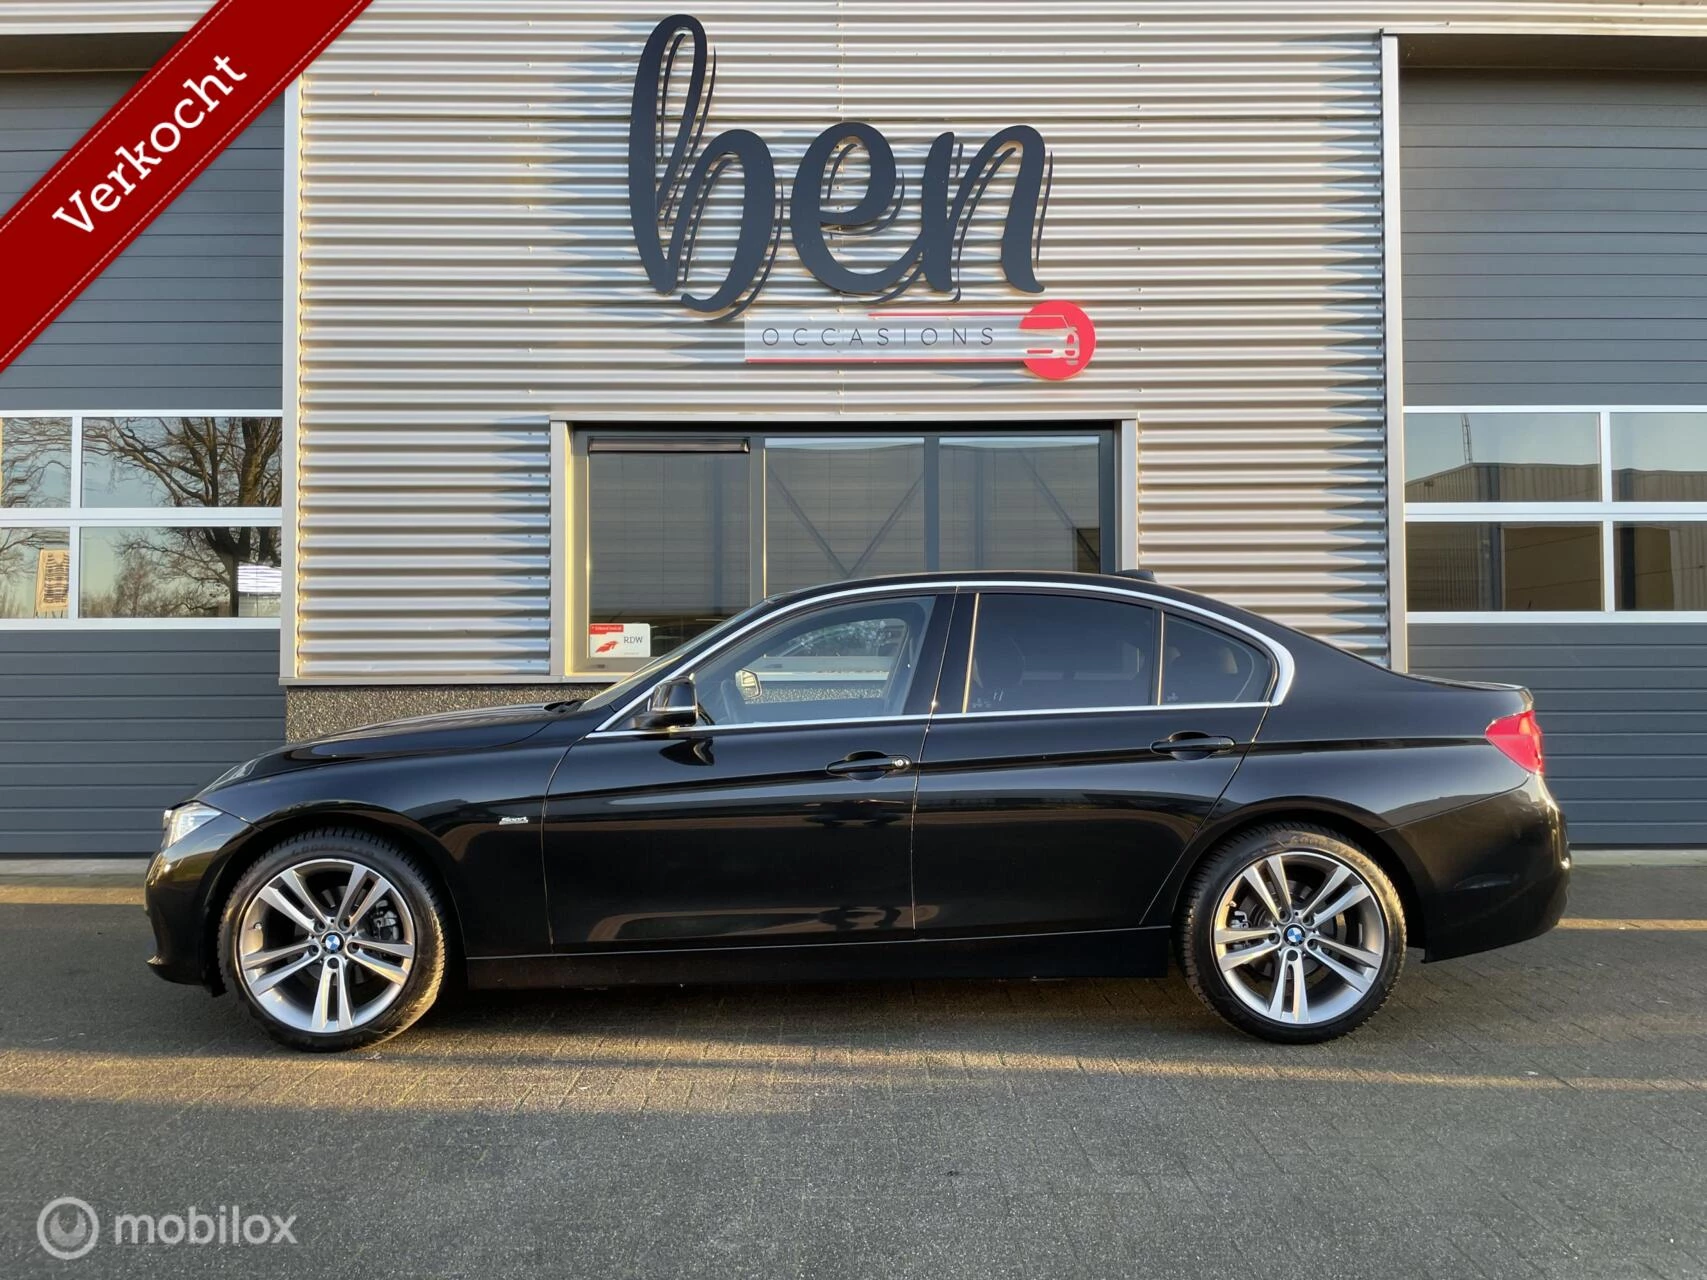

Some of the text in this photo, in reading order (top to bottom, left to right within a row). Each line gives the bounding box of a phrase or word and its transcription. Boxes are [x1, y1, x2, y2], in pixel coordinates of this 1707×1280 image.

[628, 14, 1053, 322] ben
[761, 326, 994, 347] OCCASIONS
[623, 635, 643, 644] RDW
